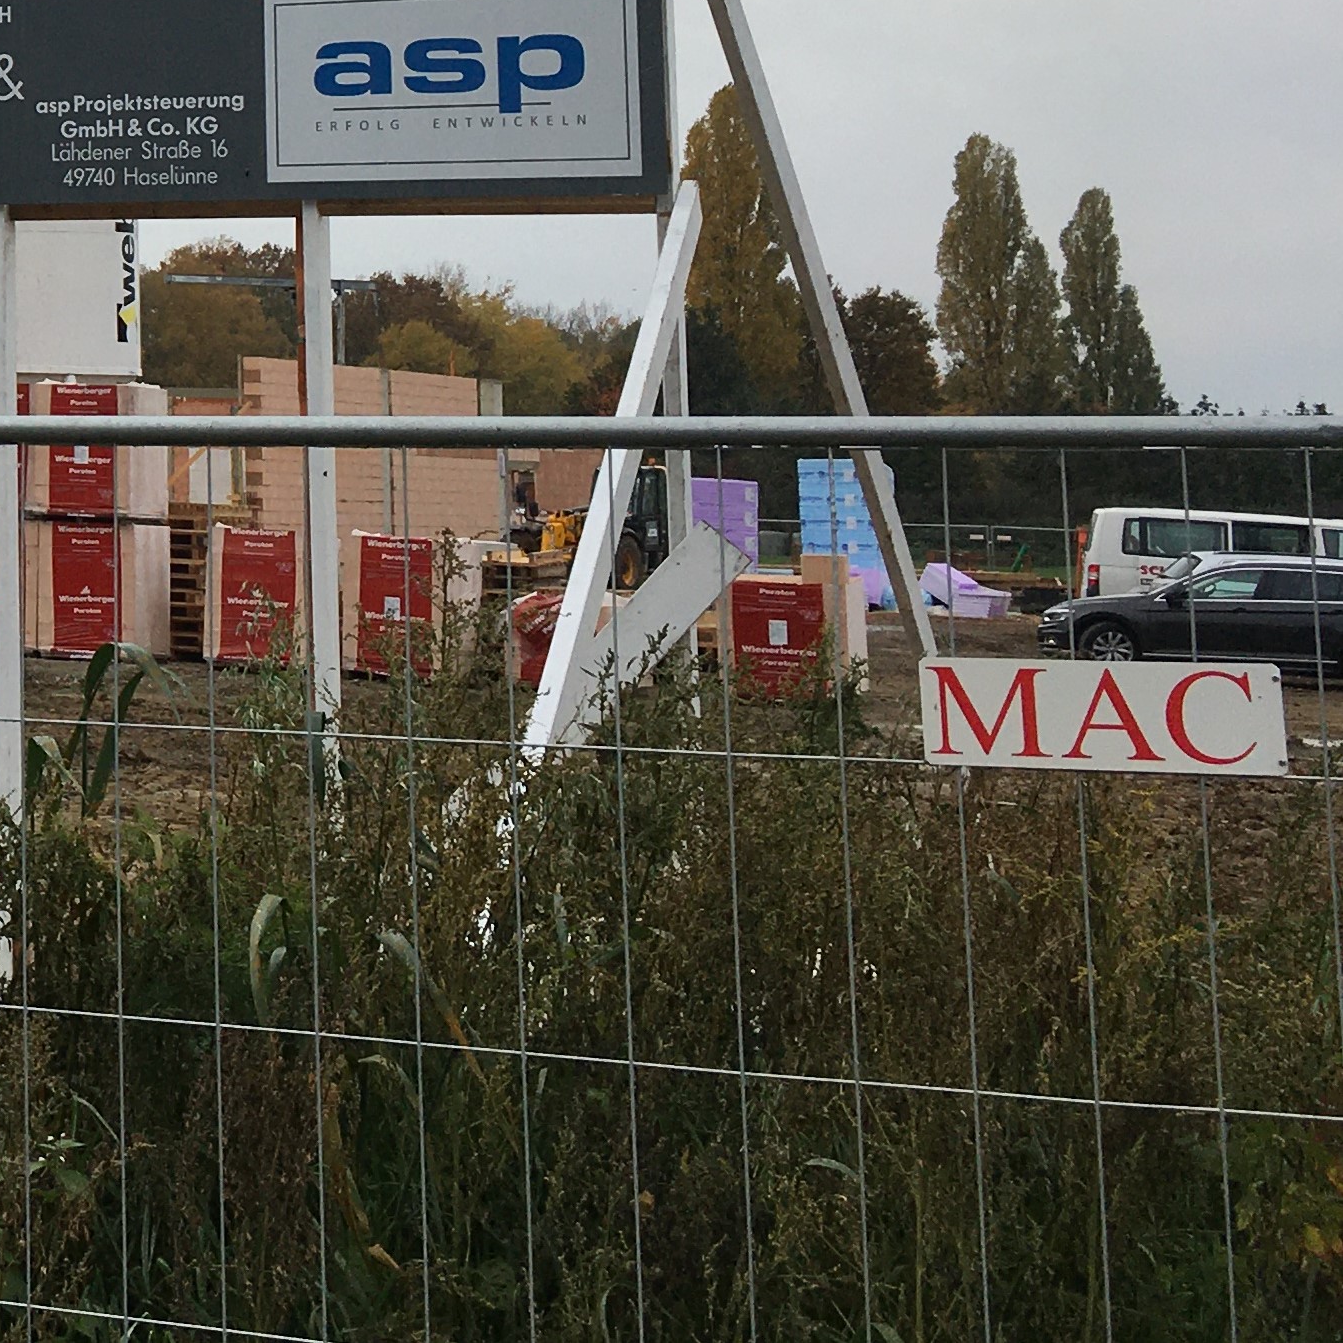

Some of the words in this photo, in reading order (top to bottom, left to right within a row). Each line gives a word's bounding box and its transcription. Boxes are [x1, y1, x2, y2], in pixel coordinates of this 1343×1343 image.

[314, 33, 585, 113] asp
[35, 98, 70, 117] asp
[73, 93, 244, 116] Projektsteuerung
[61, 120, 123, 138] GmbH
[127, 118, 143, 137] &
[147, 117, 180, 136] Co.
[185, 116, 219, 135] KG
[316, 119, 402, 132] ERFOLG
[433, 114, 588, 129] ENTWICKELN
[141, 139, 202, 159] Straße
[210, 138, 229, 158] 16
[62, 168, 115, 187] 49740
[123, 165, 219, 186] Haselünne
[925, 666, 1258, 765] MAC
